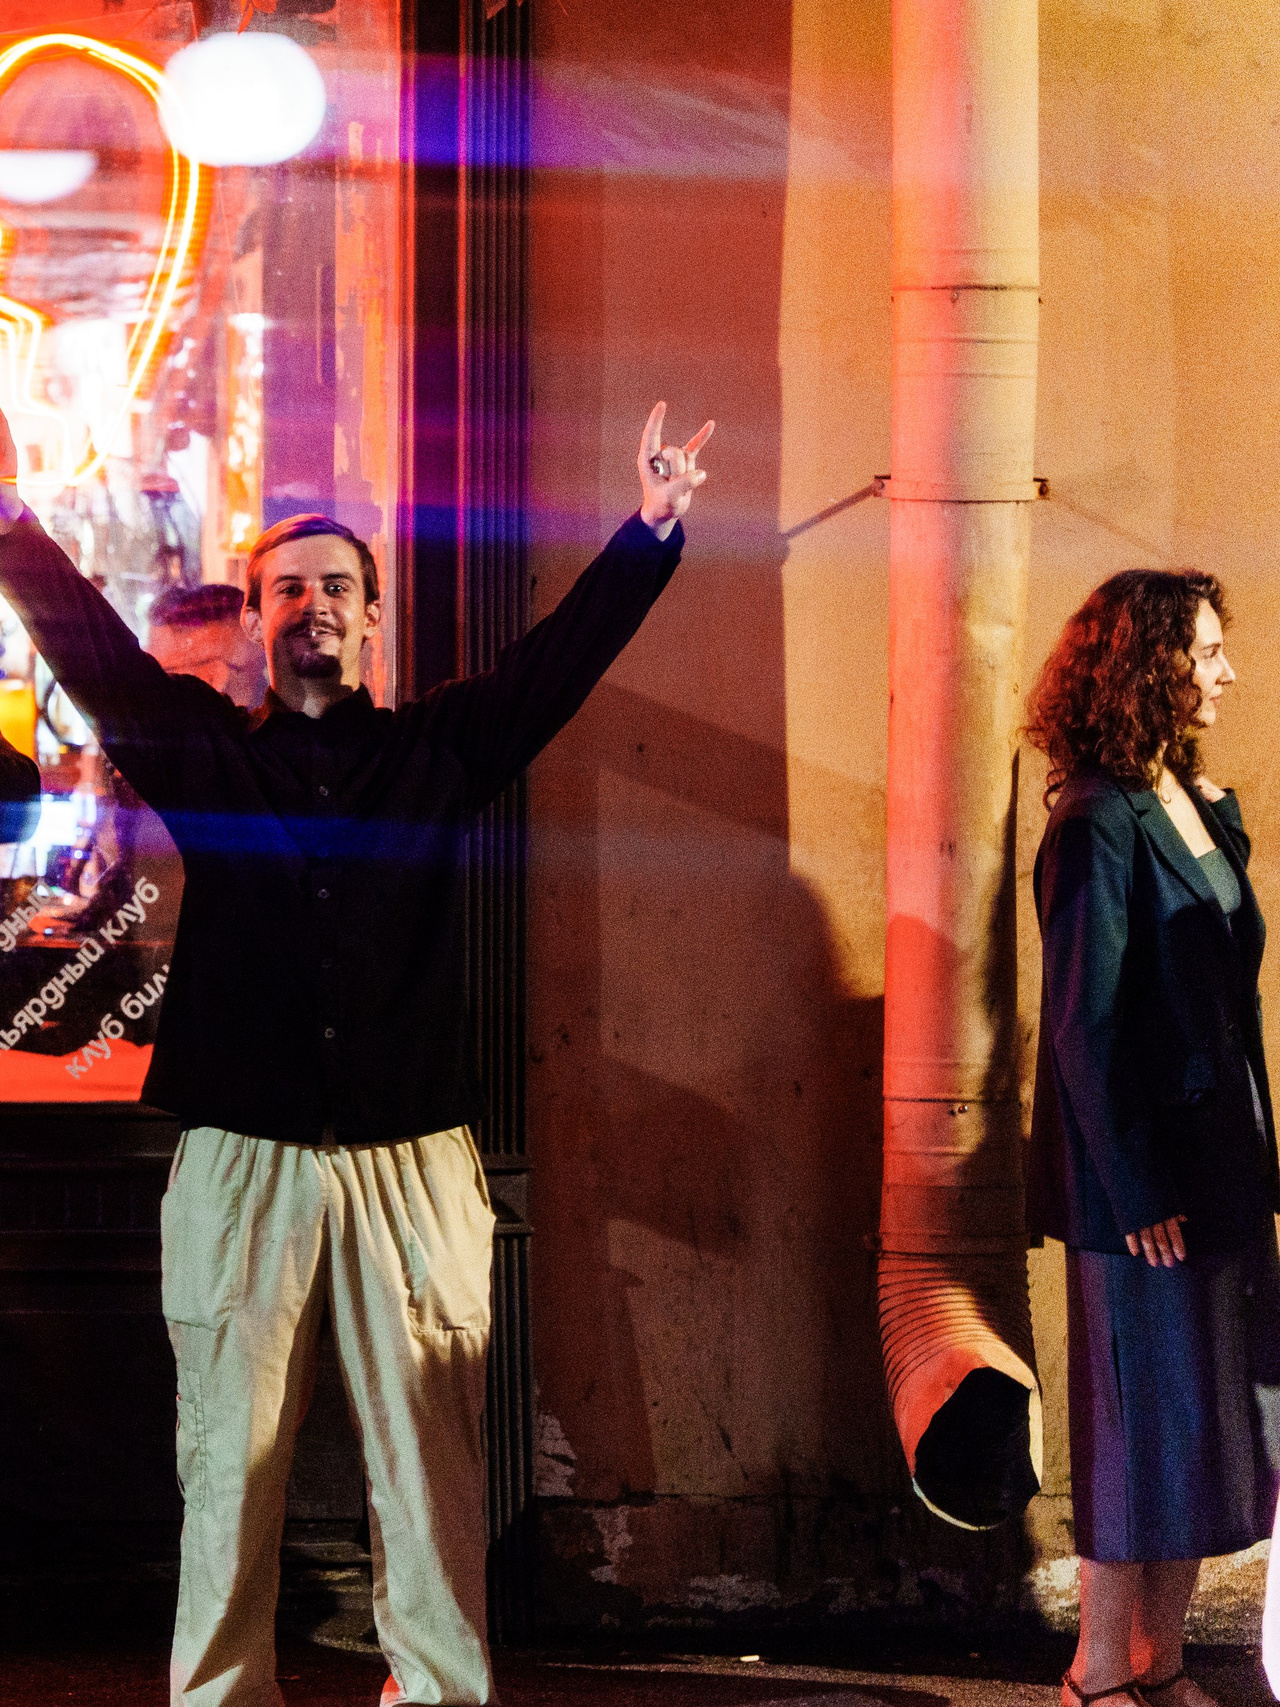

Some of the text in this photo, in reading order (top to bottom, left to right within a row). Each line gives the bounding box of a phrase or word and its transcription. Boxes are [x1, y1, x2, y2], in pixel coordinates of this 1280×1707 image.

[99, 876, 160, 945] клуб
[65, 963, 170, 1078] клуб бил
